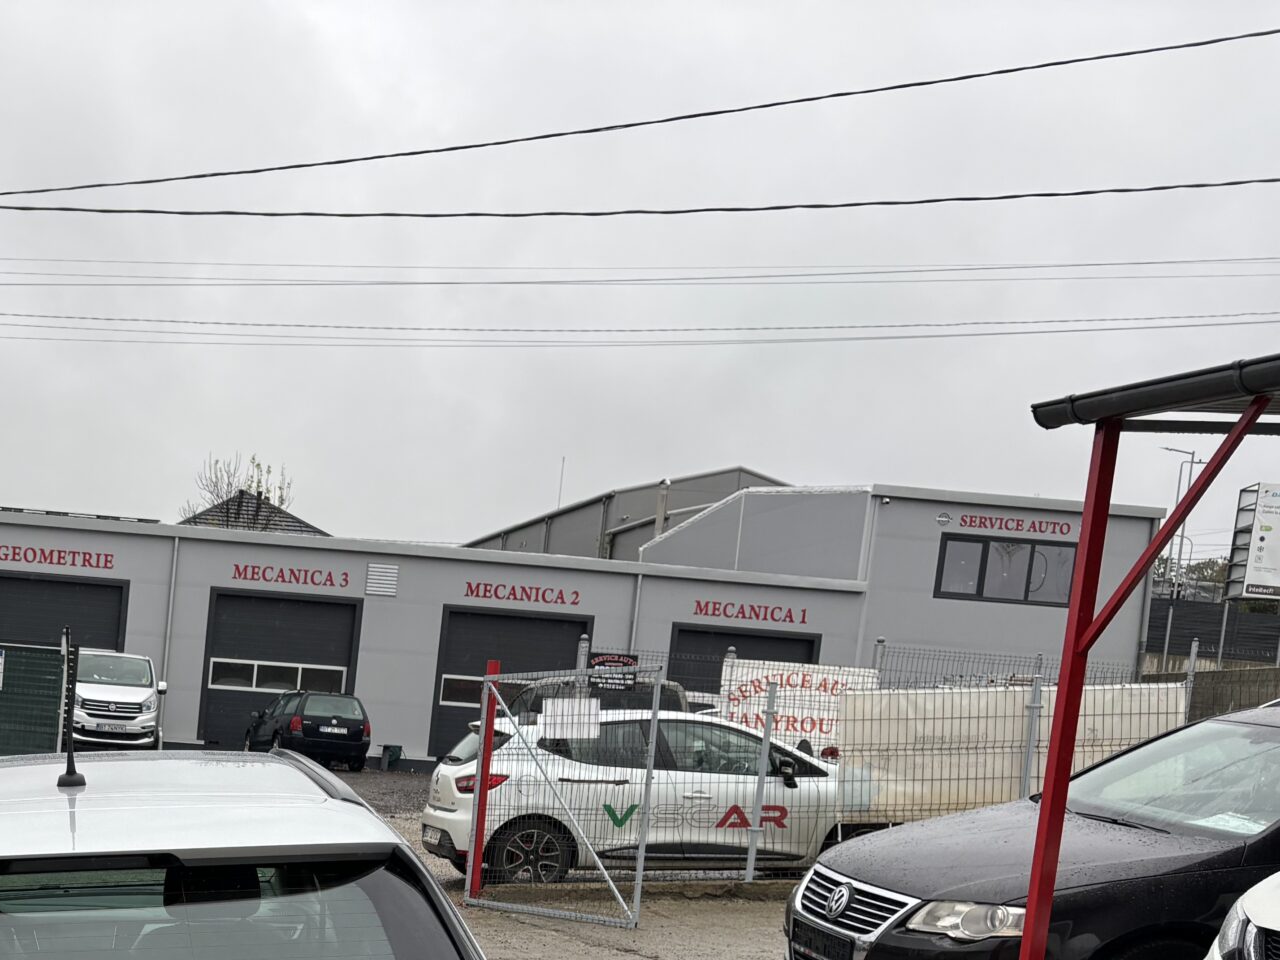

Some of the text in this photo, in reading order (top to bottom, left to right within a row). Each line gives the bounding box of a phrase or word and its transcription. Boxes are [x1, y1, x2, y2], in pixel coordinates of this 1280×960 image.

[960, 514, 1071, 536] SERVICE AUTO
[232, 564, 350, 588] MECANICA 3
[464, 581, 581, 606] MECANICA 2
[693, 600, 808, 625] MECANICA 1
[727, 672, 812, 707] SERVICE
[602, 804, 788, 828] VSCAR
